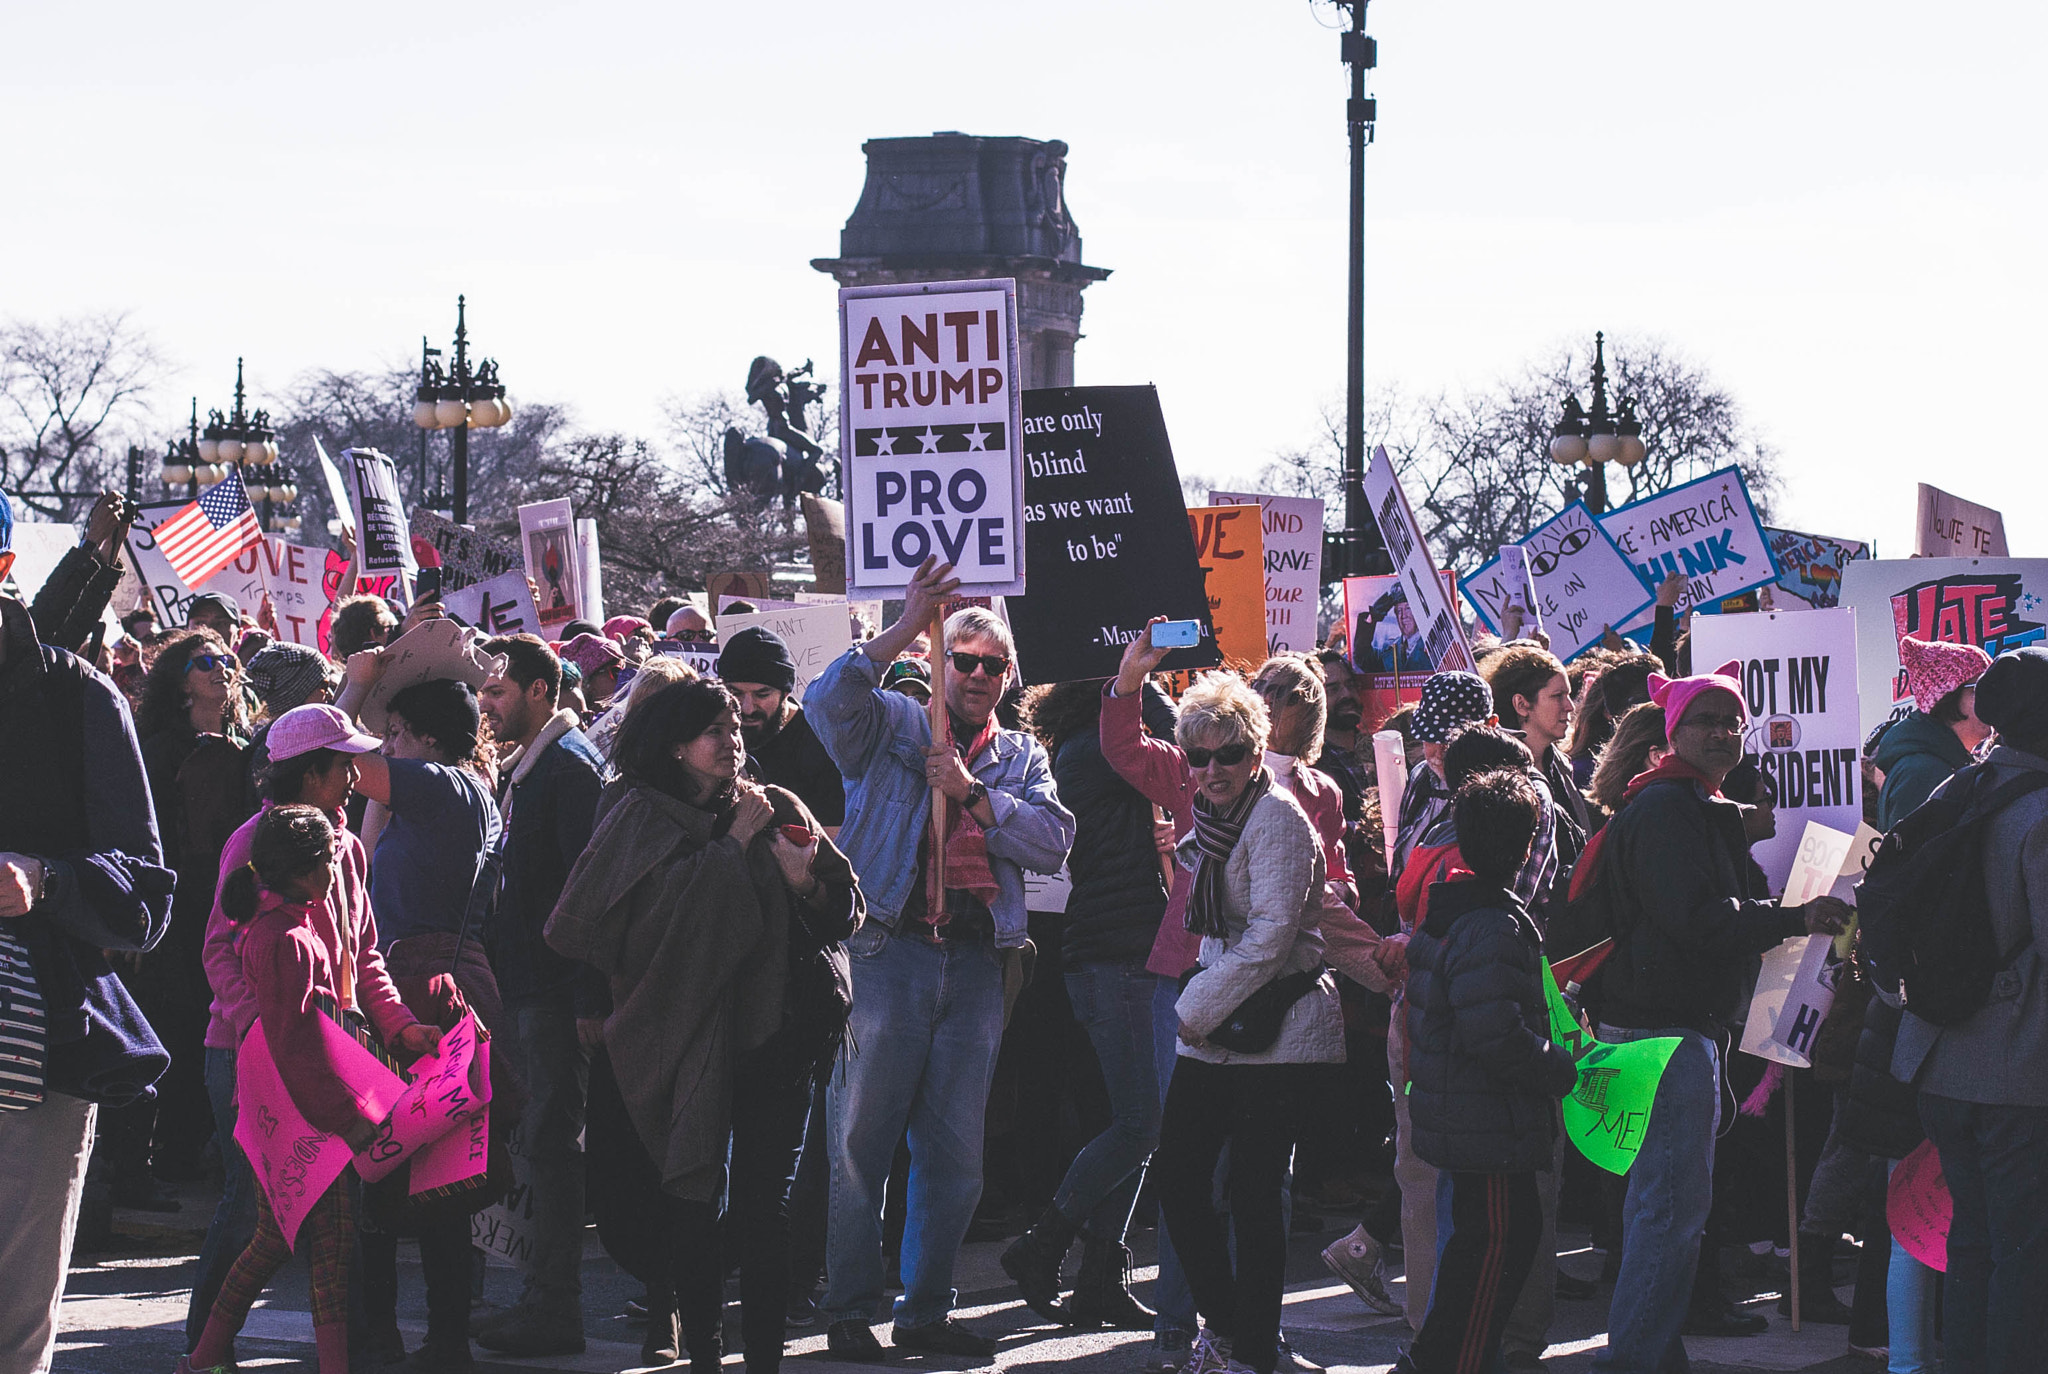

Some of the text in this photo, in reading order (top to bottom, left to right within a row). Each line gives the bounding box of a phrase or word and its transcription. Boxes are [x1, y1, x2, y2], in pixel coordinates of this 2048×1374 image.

[855, 310, 999, 368] ANTI
[856, 367, 1003, 409] TRUMP
[1023, 405, 1103, 437] are only
[1026, 448, 1087, 478] blind
[875, 468, 987, 517] PRO
[1023, 492, 1134, 522] as we want
[1650, 494, 1738, 546] AMERICA
[1972, 526, 1992, 555] TE
[221, 539, 308, 584] OVE
[862, 517, 1006, 569] LOVE
[1066, 533, 1122, 562] to be"
[1564, 571, 1586, 597] ON
[1788, 655, 1830, 714] MY
[1584, 1104, 1649, 1153] ME!
